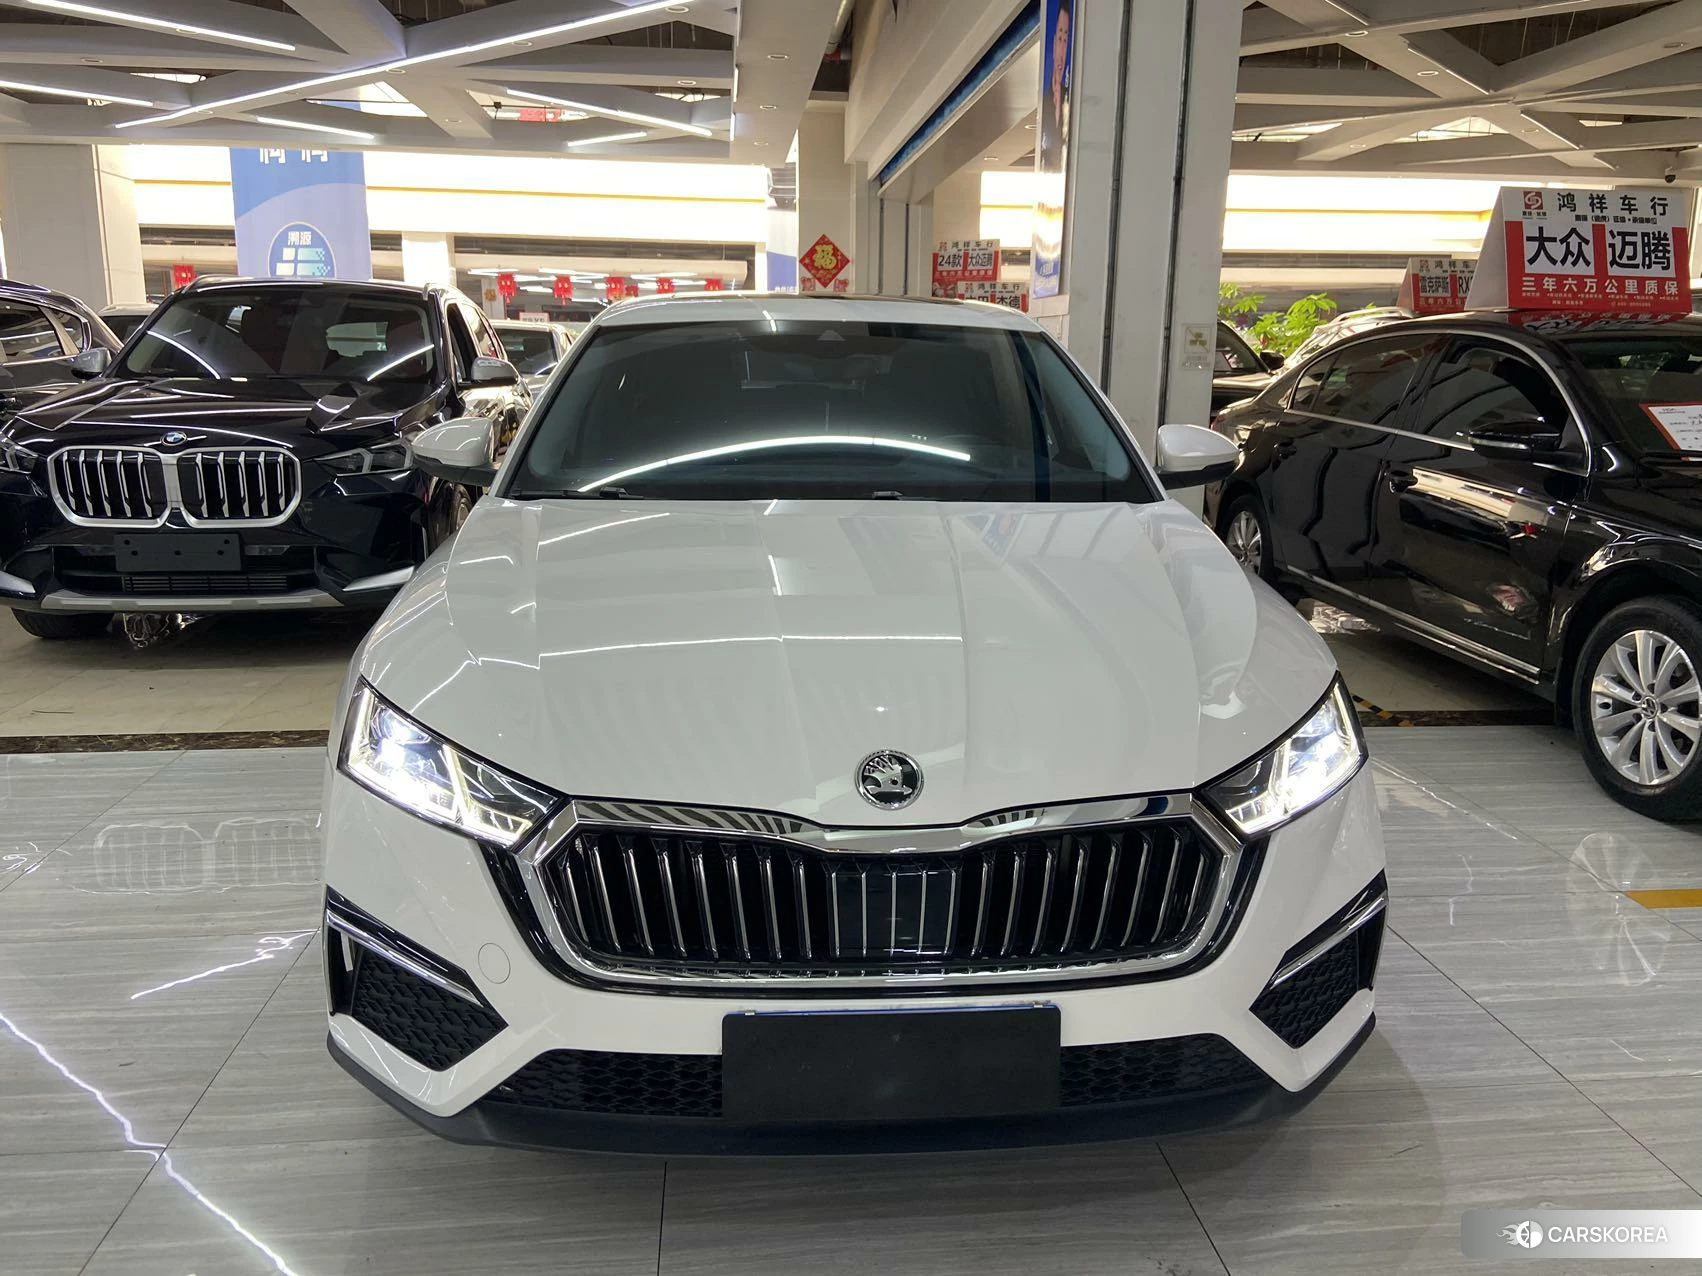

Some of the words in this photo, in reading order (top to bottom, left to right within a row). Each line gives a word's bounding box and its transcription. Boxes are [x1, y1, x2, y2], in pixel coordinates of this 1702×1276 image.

[1557, 192, 1669, 216] 鸿祥车行
[1525, 226, 1592, 268] 大众
[1608, 229, 1671, 271] 迈腾
[938, 254, 962, 268] 24款
[1522, 277, 1679, 295] 三年六万公里质保
